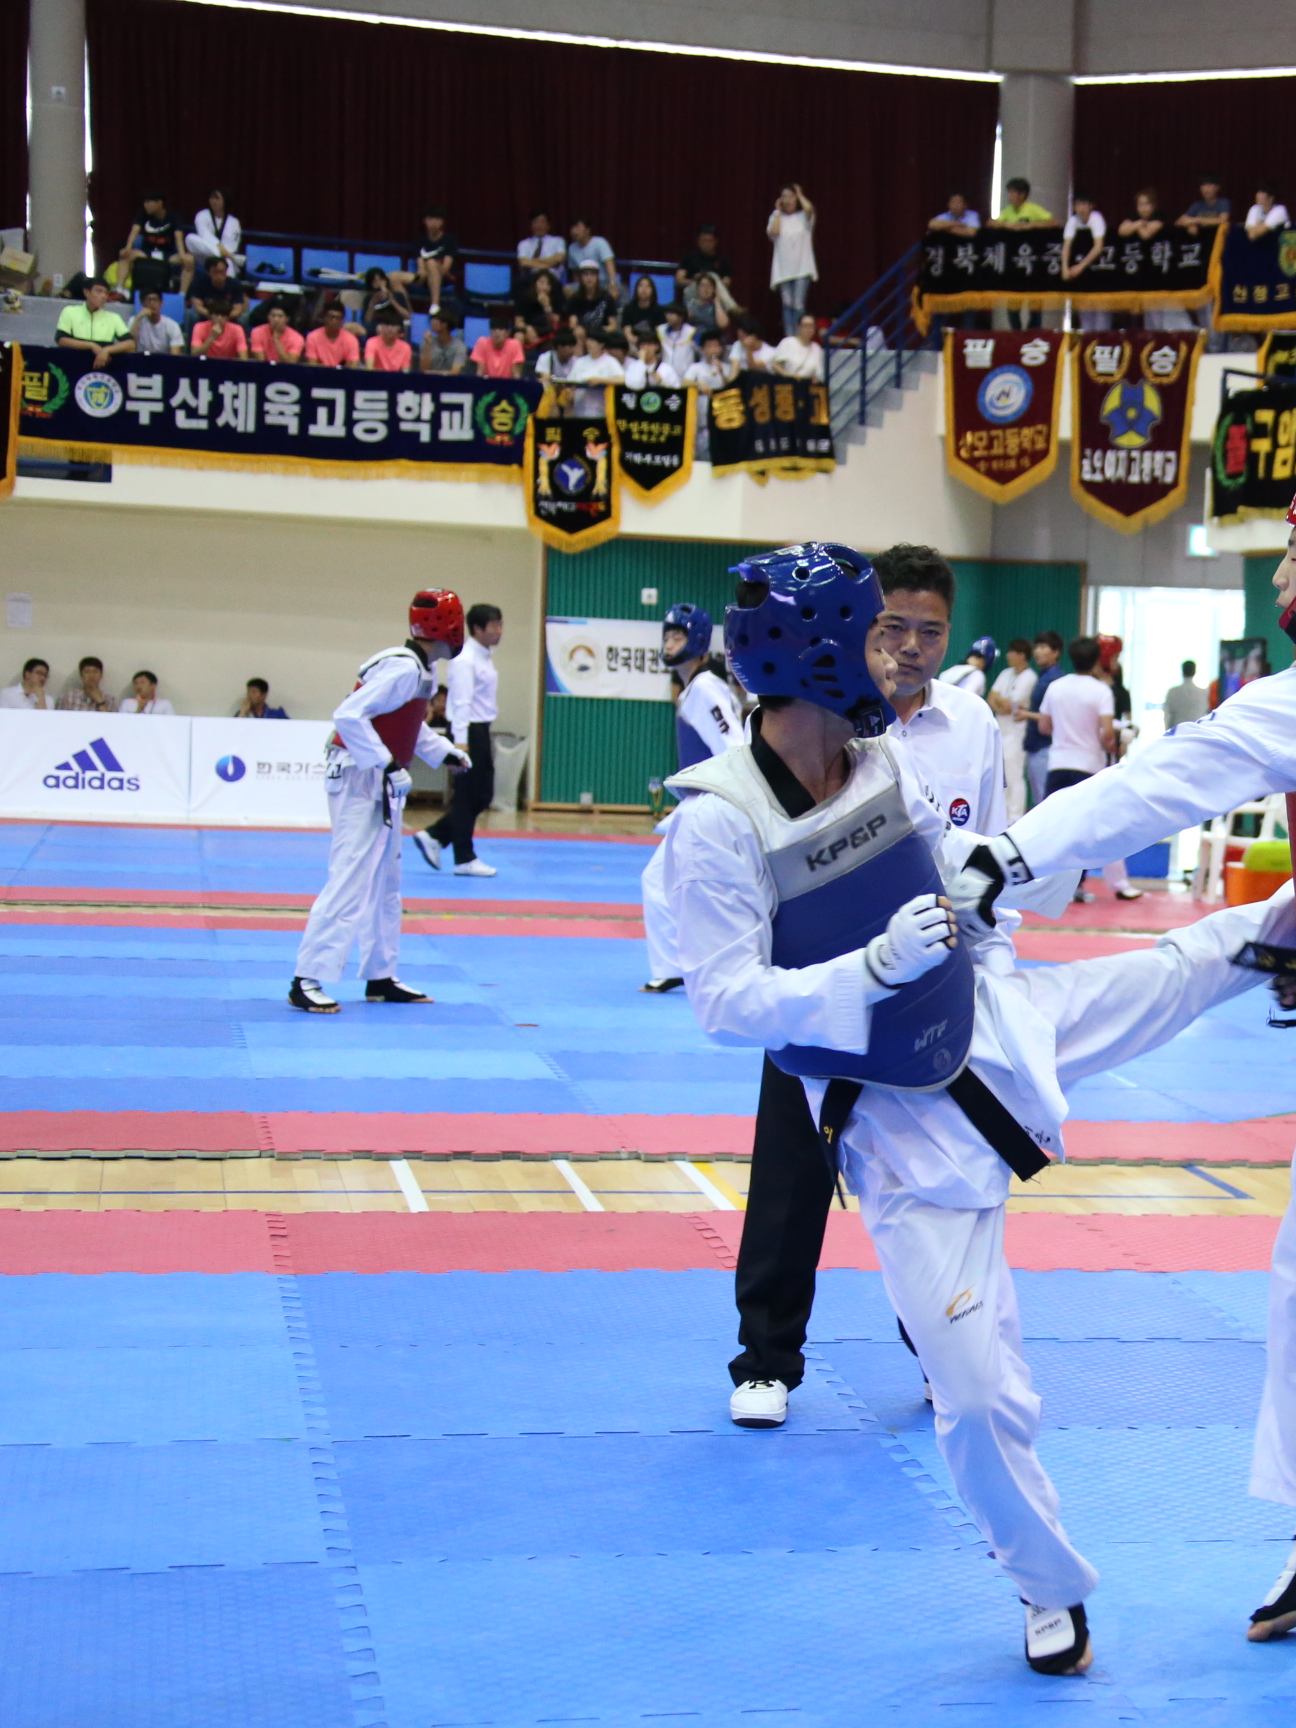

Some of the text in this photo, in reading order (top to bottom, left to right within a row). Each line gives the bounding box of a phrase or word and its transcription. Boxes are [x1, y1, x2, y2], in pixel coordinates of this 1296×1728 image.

[963, 337, 1050, 368] 필 승
[1093, 345, 1177, 373] 필 승
[21, 370, 50, 401] 필
[125, 372, 475, 444] 부산체육고등학교
[489, 399, 516, 431] 승
[606, 644, 673, 674] 한국태권
[42, 771, 141, 792] adidas
[804, 812, 888, 872] KP&P
